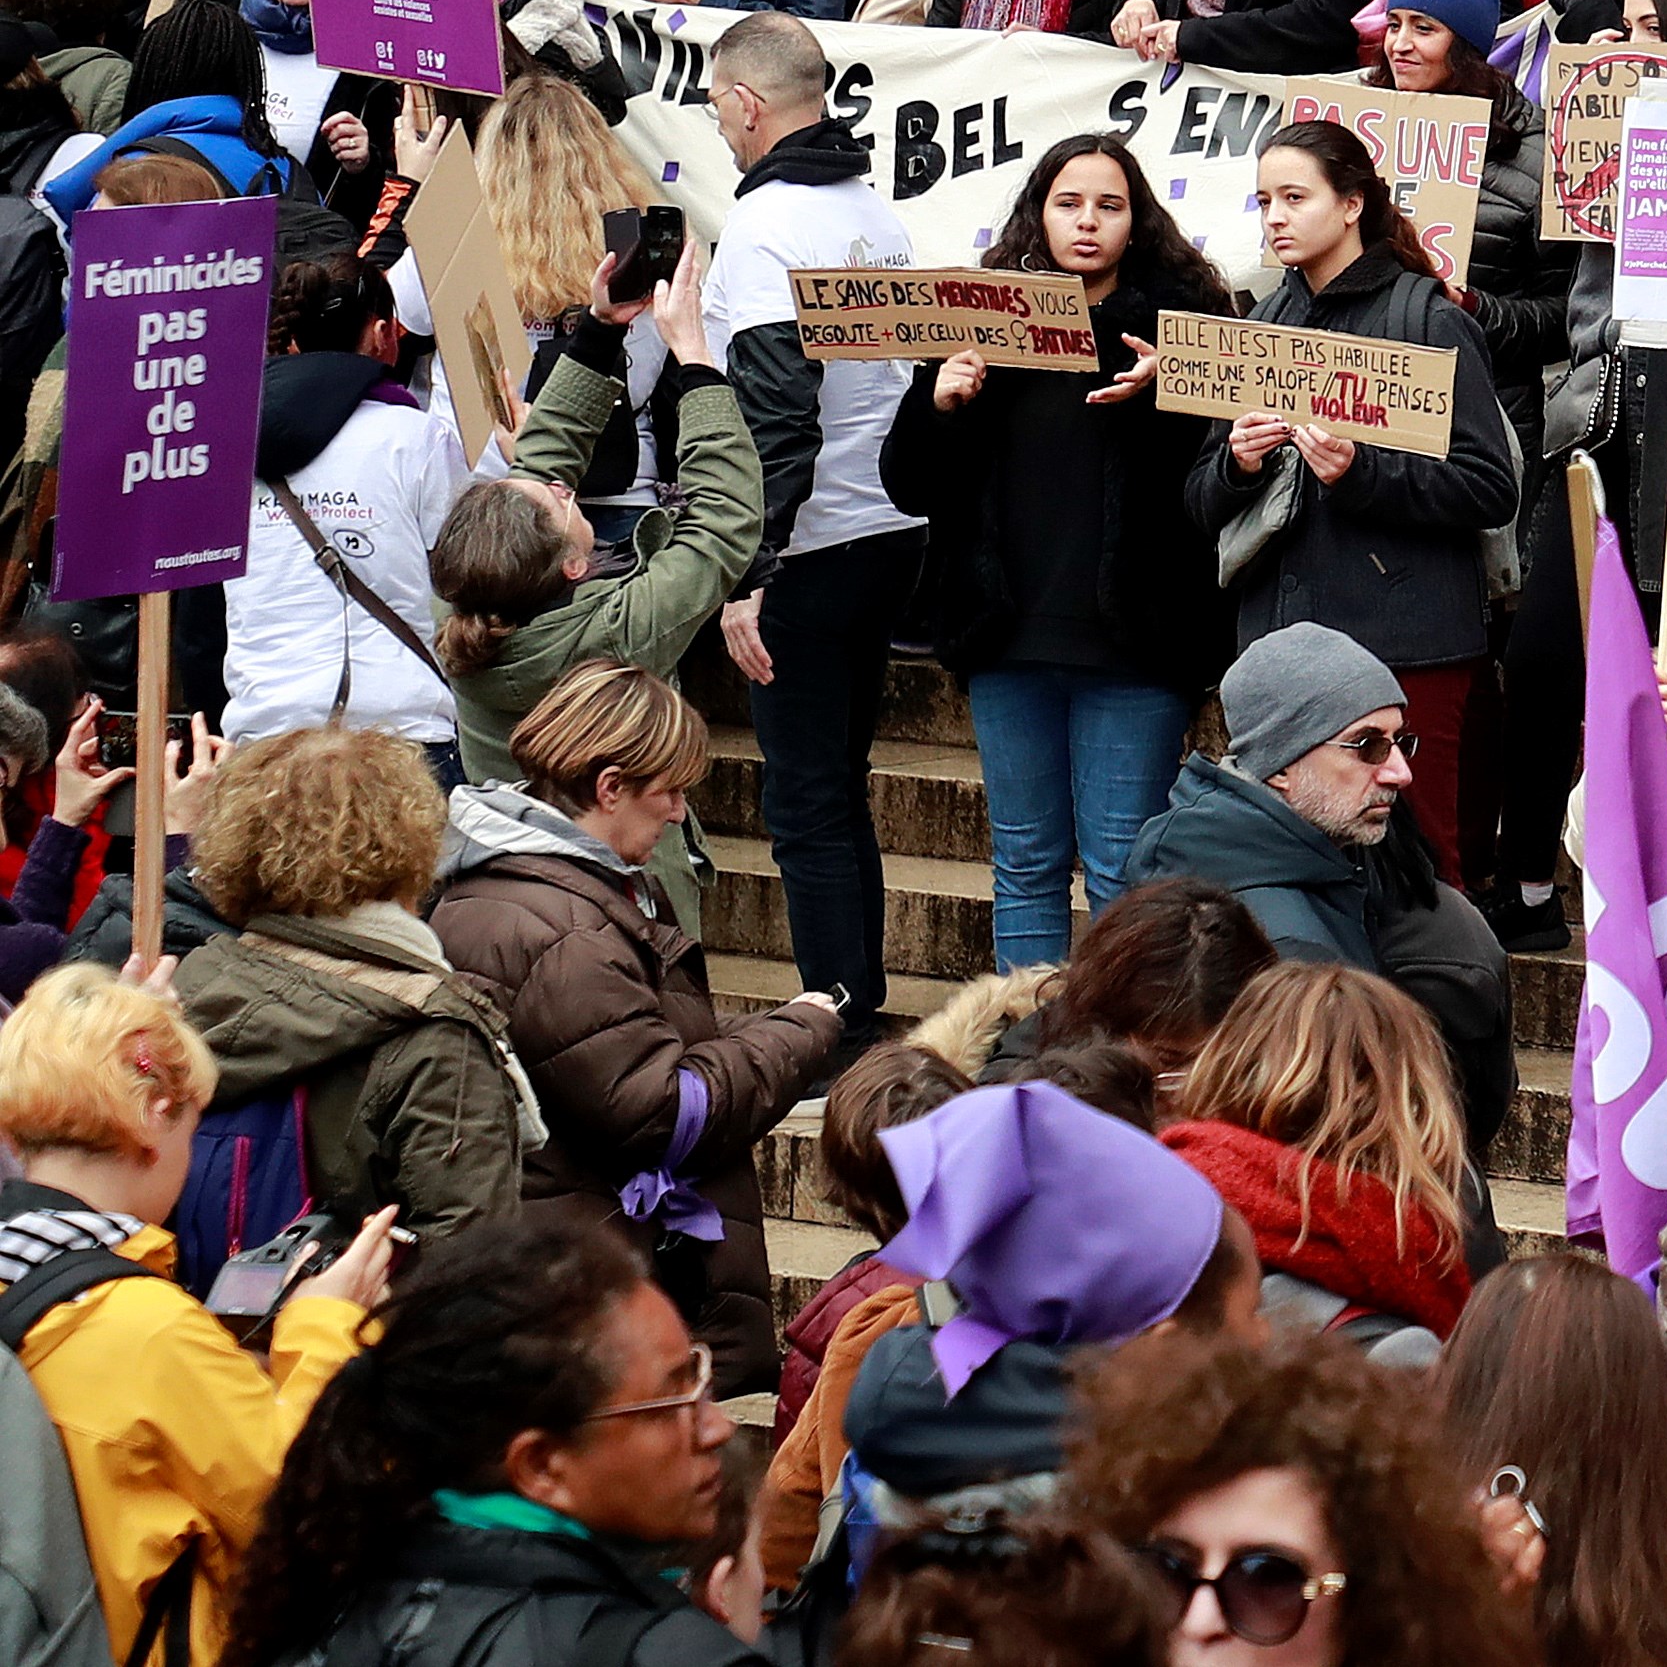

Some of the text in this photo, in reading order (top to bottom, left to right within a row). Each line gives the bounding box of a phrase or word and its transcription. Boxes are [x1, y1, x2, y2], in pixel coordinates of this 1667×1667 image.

[893, 92, 1024, 201] BEL
[1394, 115, 1490, 188] UNE
[1631, 138, 1658, 151] Une
[1629, 163, 1653, 177] des
[84, 247, 264, 300] Féminicides
[796, 279, 834, 310] LE
[837, 278, 888, 309] SANG
[892, 281, 934, 307] DES
[1031, 291, 1080, 317] VOUS
[137, 307, 209, 356] pas
[801, 322, 876, 345] DEGOUTE
[895, 322, 927, 346] QUE
[977, 326, 1010, 348] DES
[1163, 318, 1210, 349] ELLE
[1218, 325, 1282, 358] N'EST
[1290, 337, 1327, 365] PAS
[133, 352, 208, 391] une
[1158, 354, 1448, 416] COMME UNE SALOPE TU PENSES
[146, 390, 197, 436] de
[1163, 374, 1390, 430] COMME UN VIOLEUR
[121, 436, 211, 494] plus
[308, 492, 360, 507] MAGA
[321, 505, 374, 521] Protect
[154, 544, 243, 571] noustoutes.org
